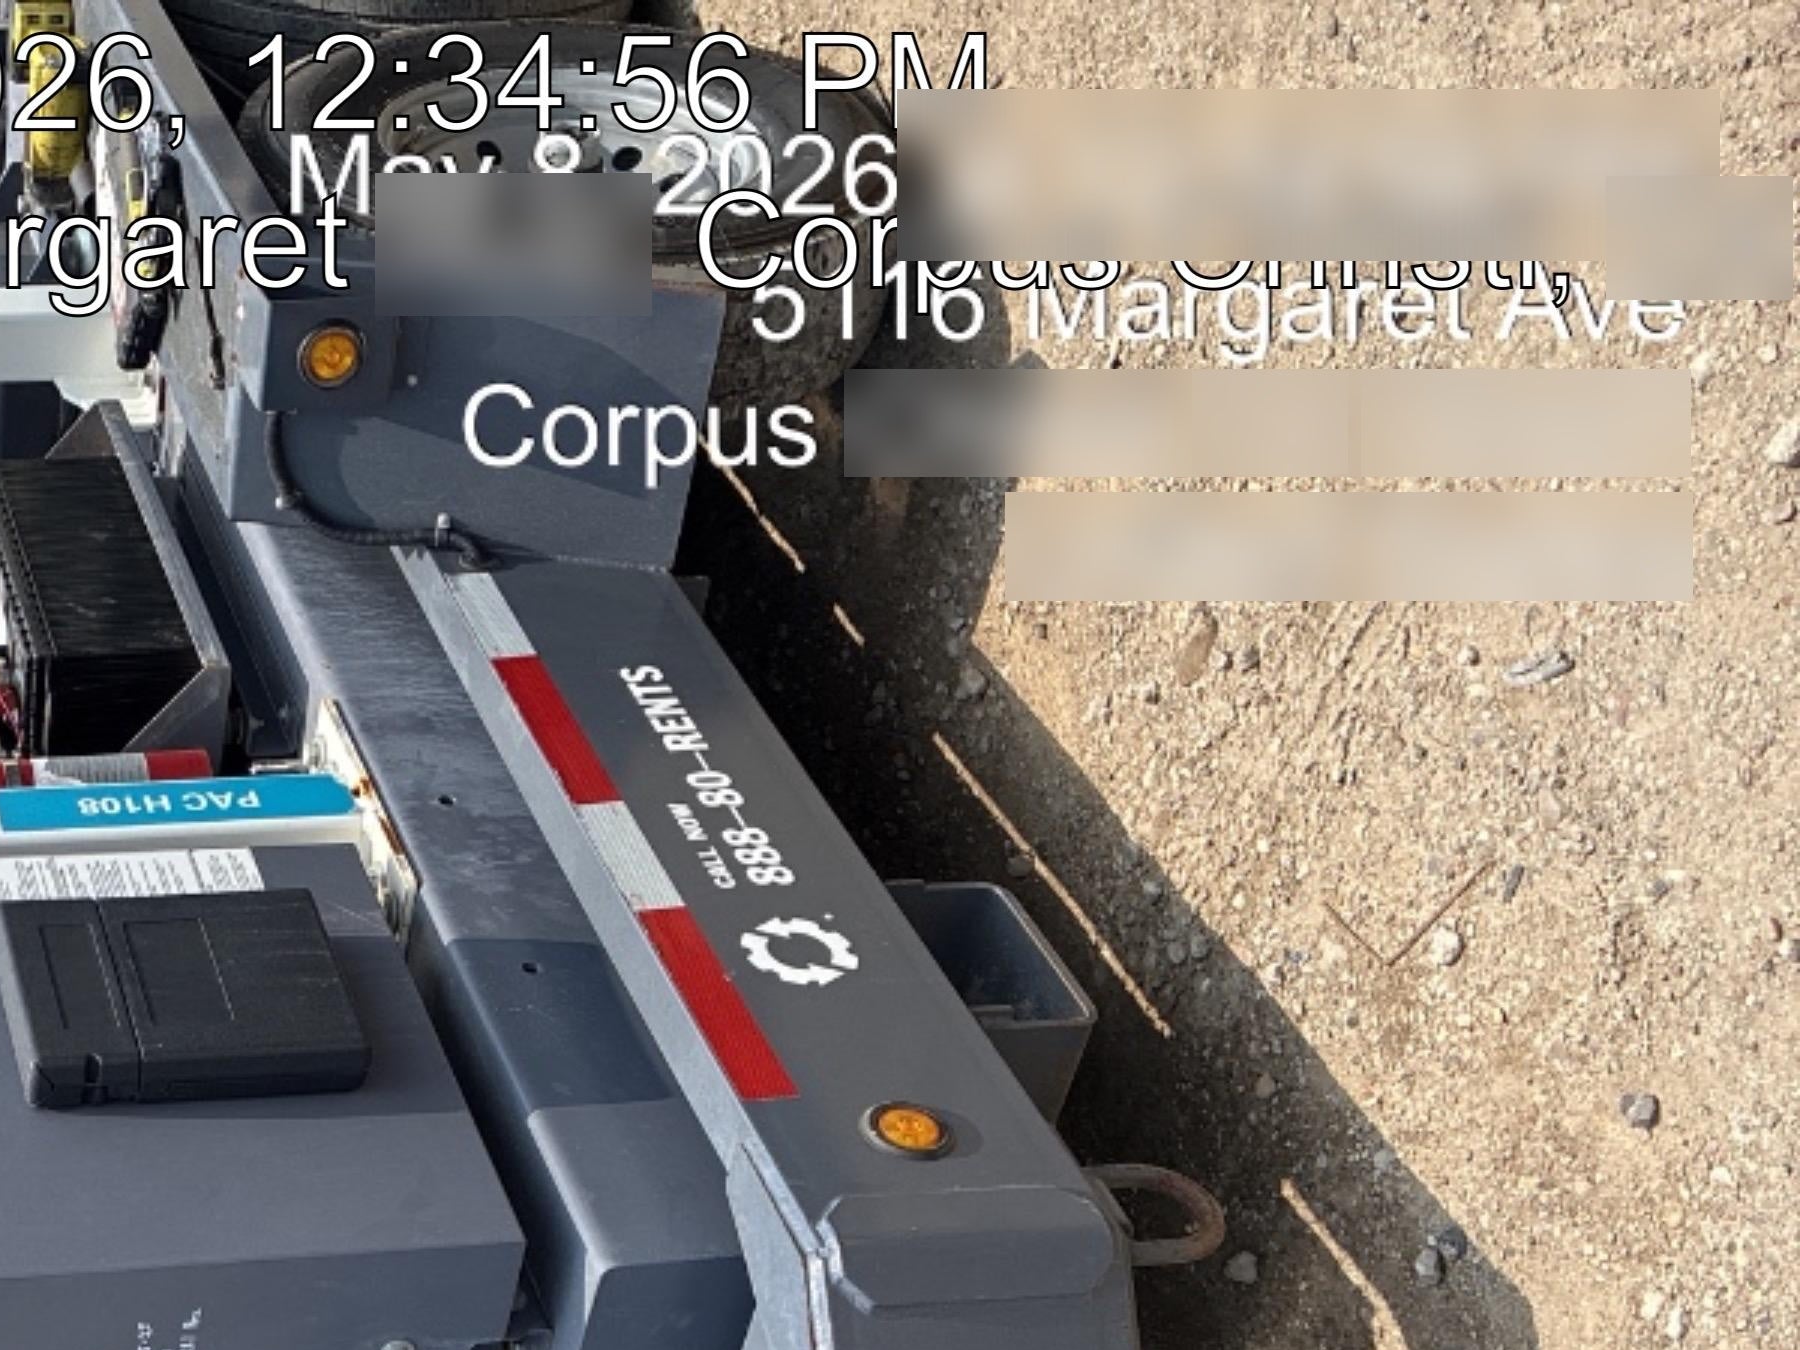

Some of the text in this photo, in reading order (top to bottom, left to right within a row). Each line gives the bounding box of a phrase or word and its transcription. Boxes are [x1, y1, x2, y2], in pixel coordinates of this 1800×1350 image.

[77, 790, 261, 816] PAC H108
[619, 664, 794, 886] 888-80-RENTS
[666, 803, 735, 888] CALL NOW
